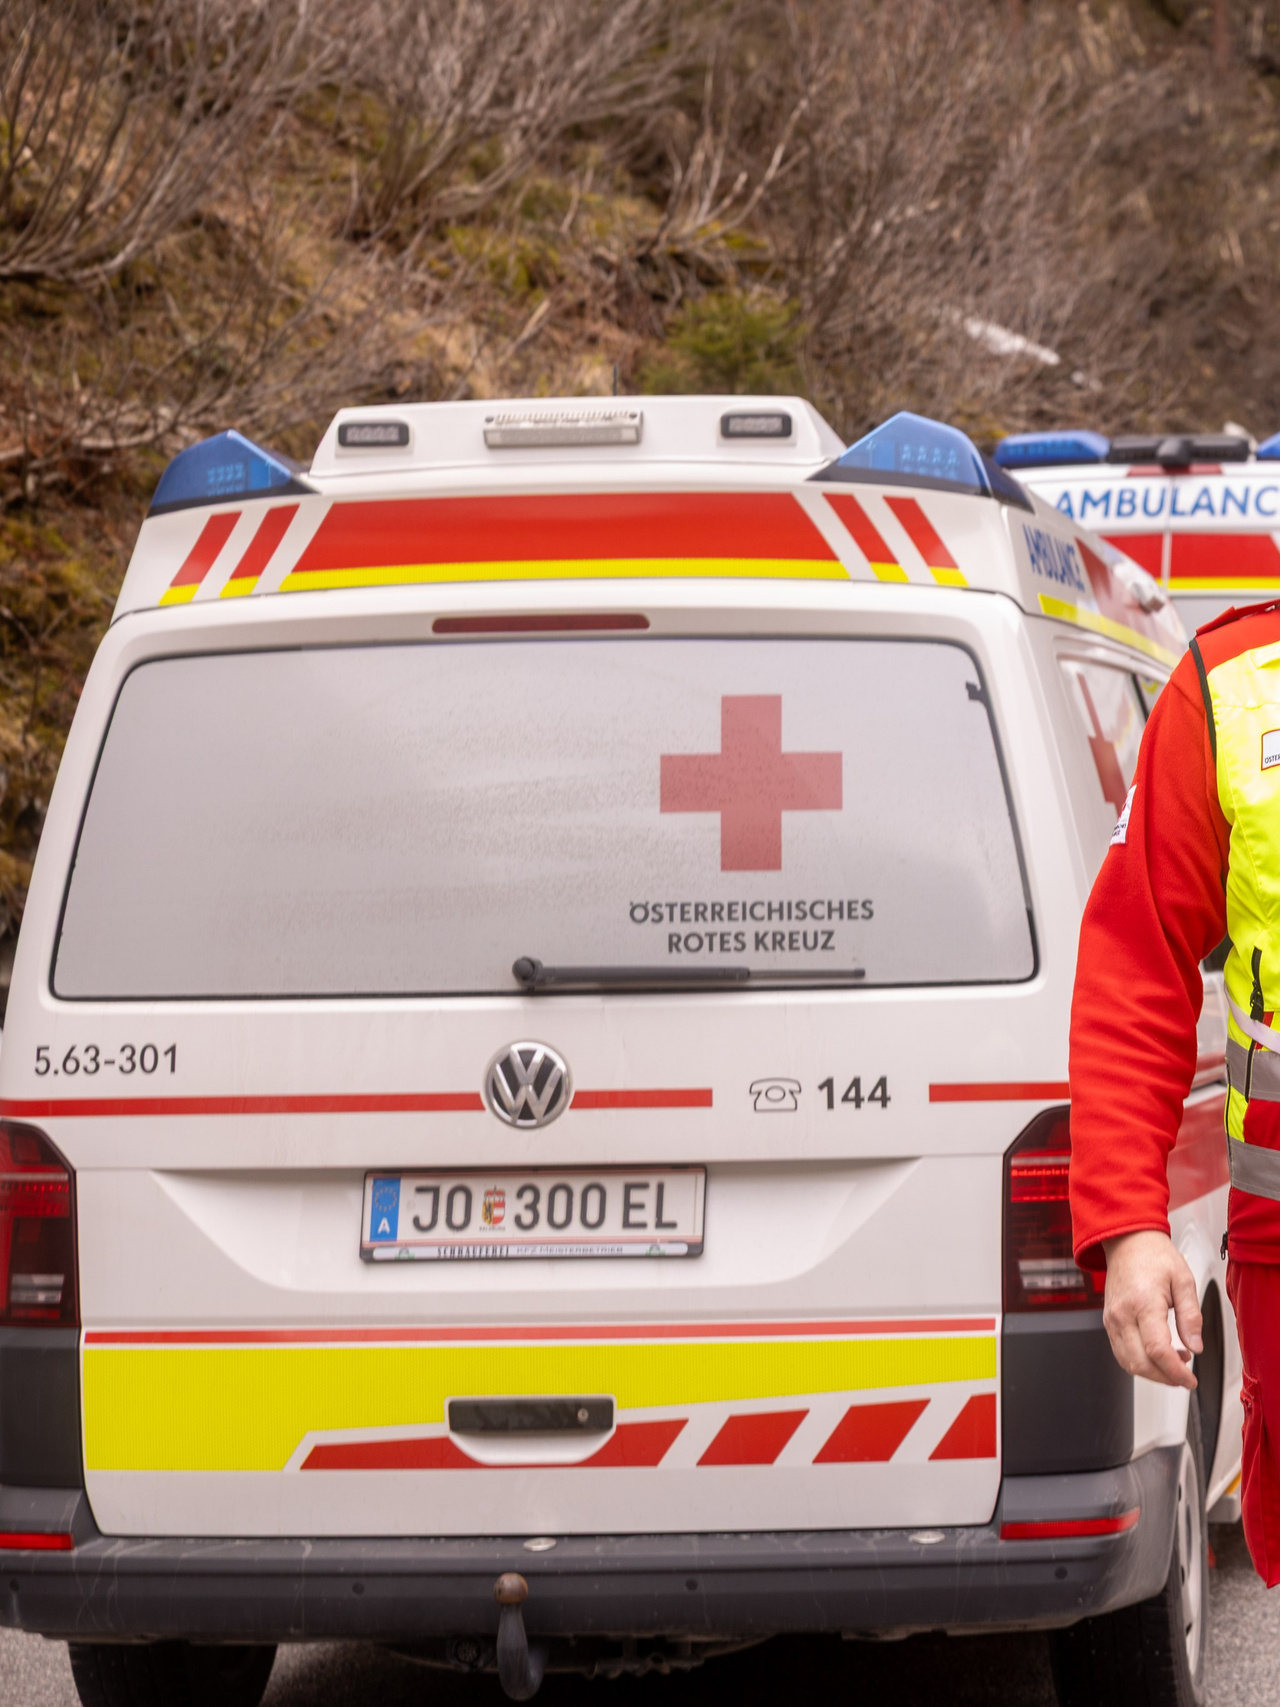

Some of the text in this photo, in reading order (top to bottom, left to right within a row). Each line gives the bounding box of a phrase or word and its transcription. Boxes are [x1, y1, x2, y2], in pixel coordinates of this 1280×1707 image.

[1022, 523, 1085, 593] AMBULANCE
[629, 899, 875, 924] ÖSTERREICHISCHES
[667, 930, 836, 954] ROTES KREUZ
[34, 1042, 177, 1077] 5.63-301
[817, 1075, 892, 1111] 144
[412, 1181, 678, 1233] JO 300 EL
[377, 1217, 391, 1235] A
